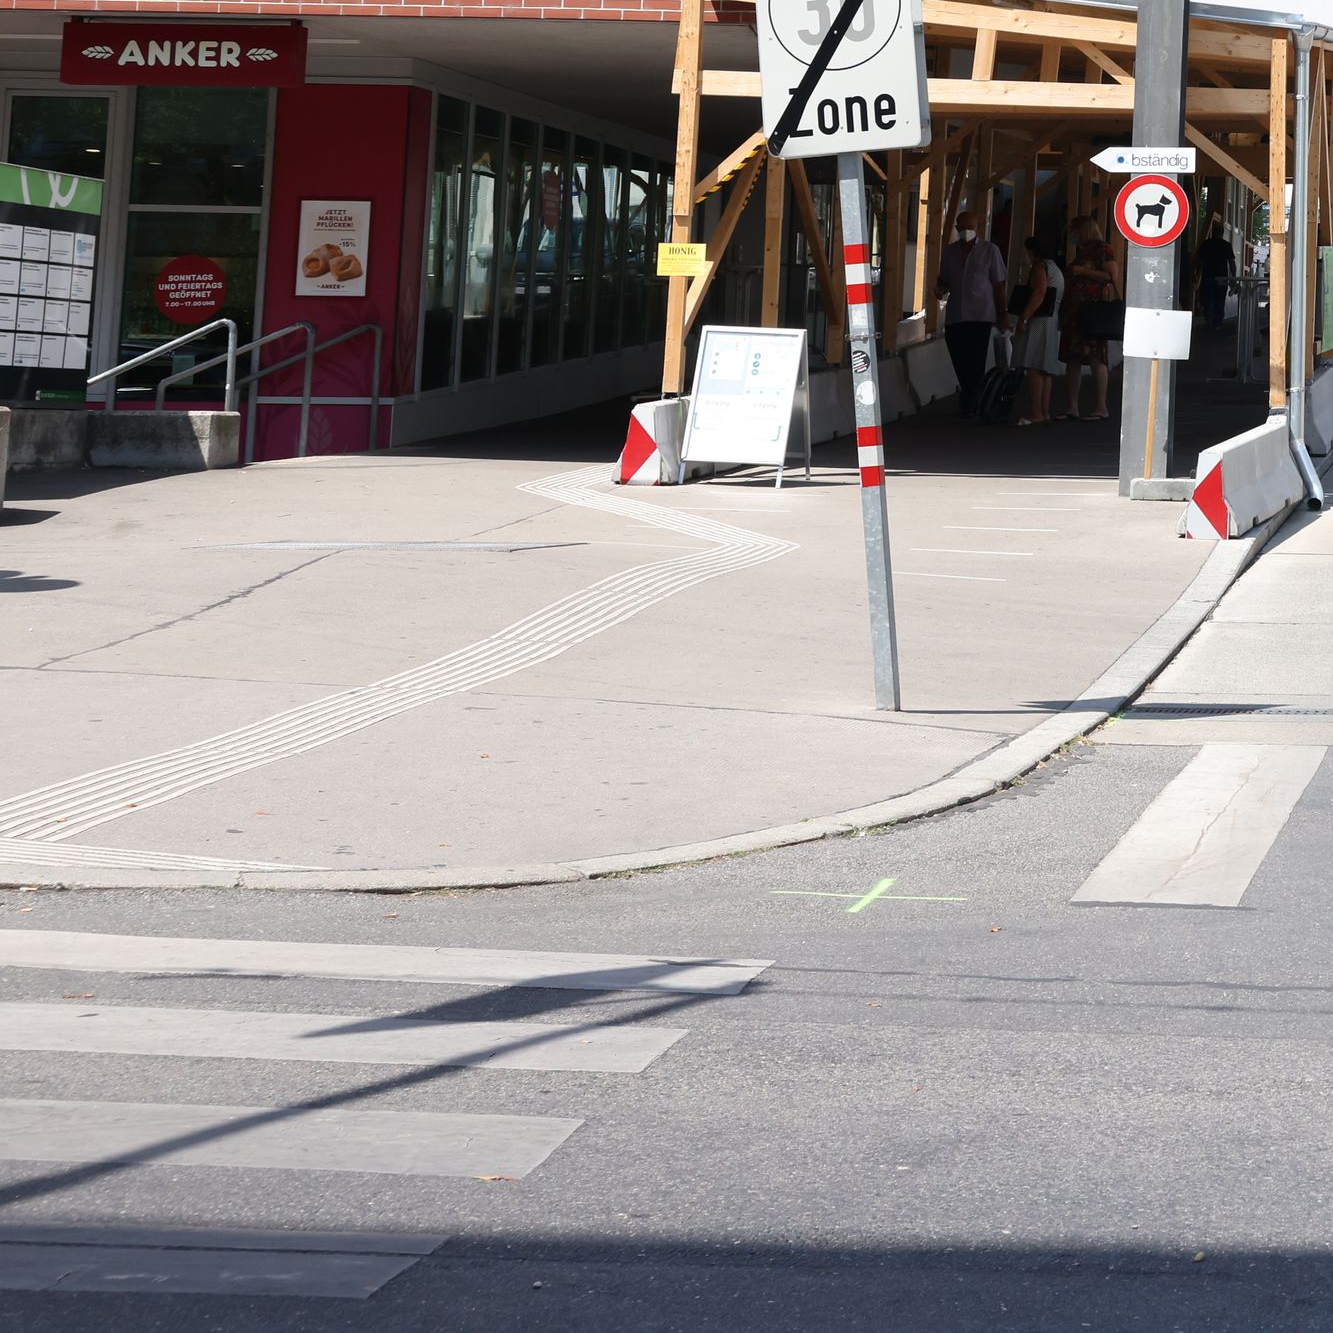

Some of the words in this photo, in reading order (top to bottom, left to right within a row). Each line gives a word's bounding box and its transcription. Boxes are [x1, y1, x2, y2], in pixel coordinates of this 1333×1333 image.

[117, 39, 242, 68] ANKER
[1131, 153, 1189, 170] bständig
[668, 246, 697, 256] HONIG
[168, 274, 214, 282] SONNTAGS
[177, 282, 223, 290] FEIERTAGS
[169, 290, 212, 299] GEÖFFNET
